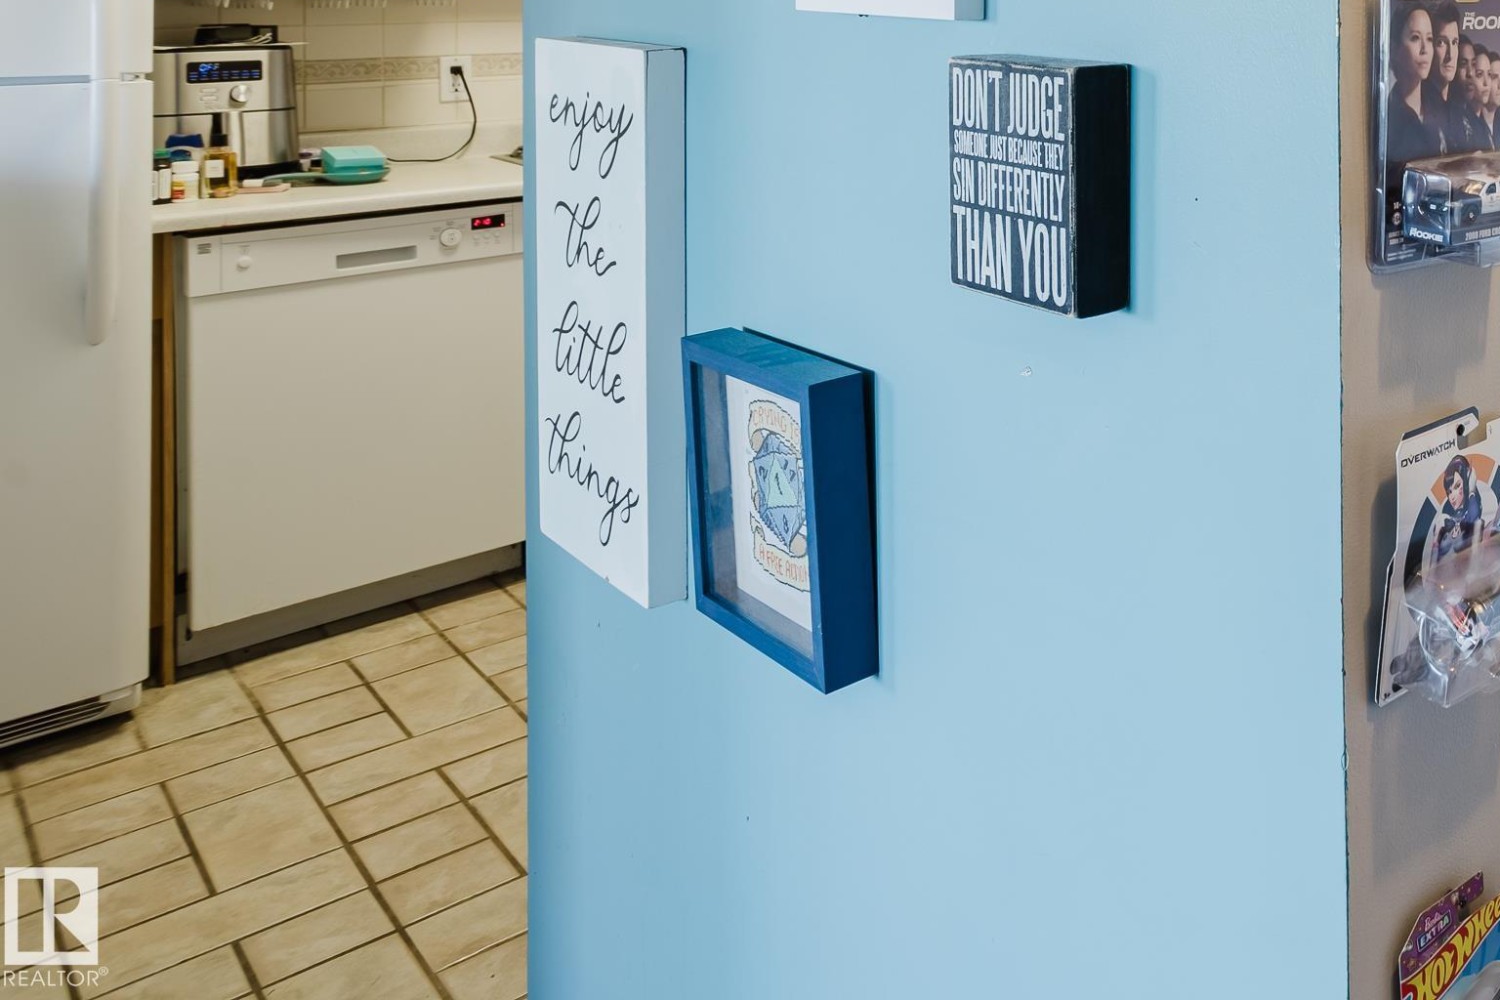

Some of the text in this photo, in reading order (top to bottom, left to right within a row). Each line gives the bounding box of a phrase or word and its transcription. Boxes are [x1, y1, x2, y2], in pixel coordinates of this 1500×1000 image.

[549, 91, 634, 179] enjoy
[952, 66, 1066, 142] DON'T JUDGE
[953, 157, 1066, 222] SIN DIFFERENTLY
[954, 129, 1065, 171] SOMEONE JUST BECAUSE THEY
[554, 196, 617, 276] the
[952, 204, 1068, 307] THAN YOU
[552, 300, 628, 404] little
[544, 411, 640, 546] things
[1400, 438, 1456, 468] OVERWATCH
